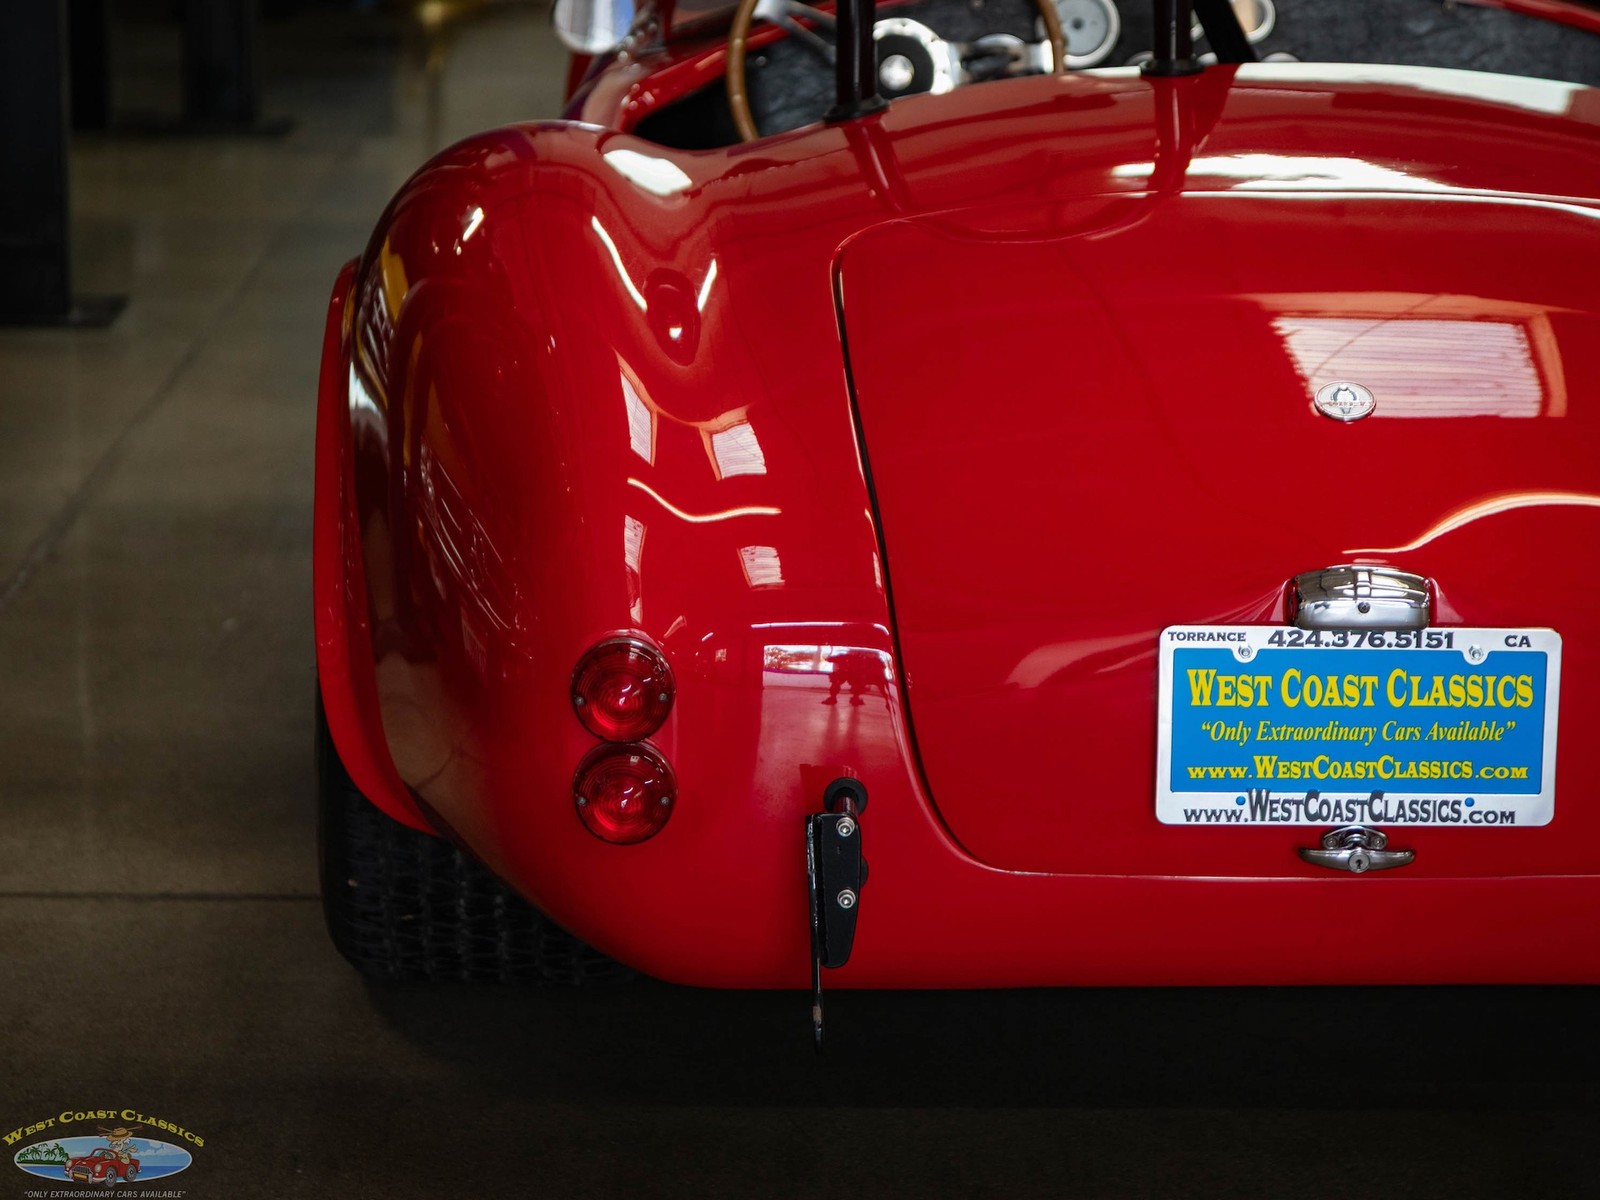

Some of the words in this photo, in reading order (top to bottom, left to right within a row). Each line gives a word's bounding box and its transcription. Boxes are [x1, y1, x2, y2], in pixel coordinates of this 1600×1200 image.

[1168, 631, 1246, 642] TORRANCE
[1268, 629, 1454, 649] 424.376.5151
[1504, 634, 1532, 648] CA
[1256, 720, 1378, 747] Extraordinary
[1382, 720, 1421, 741] Cars
